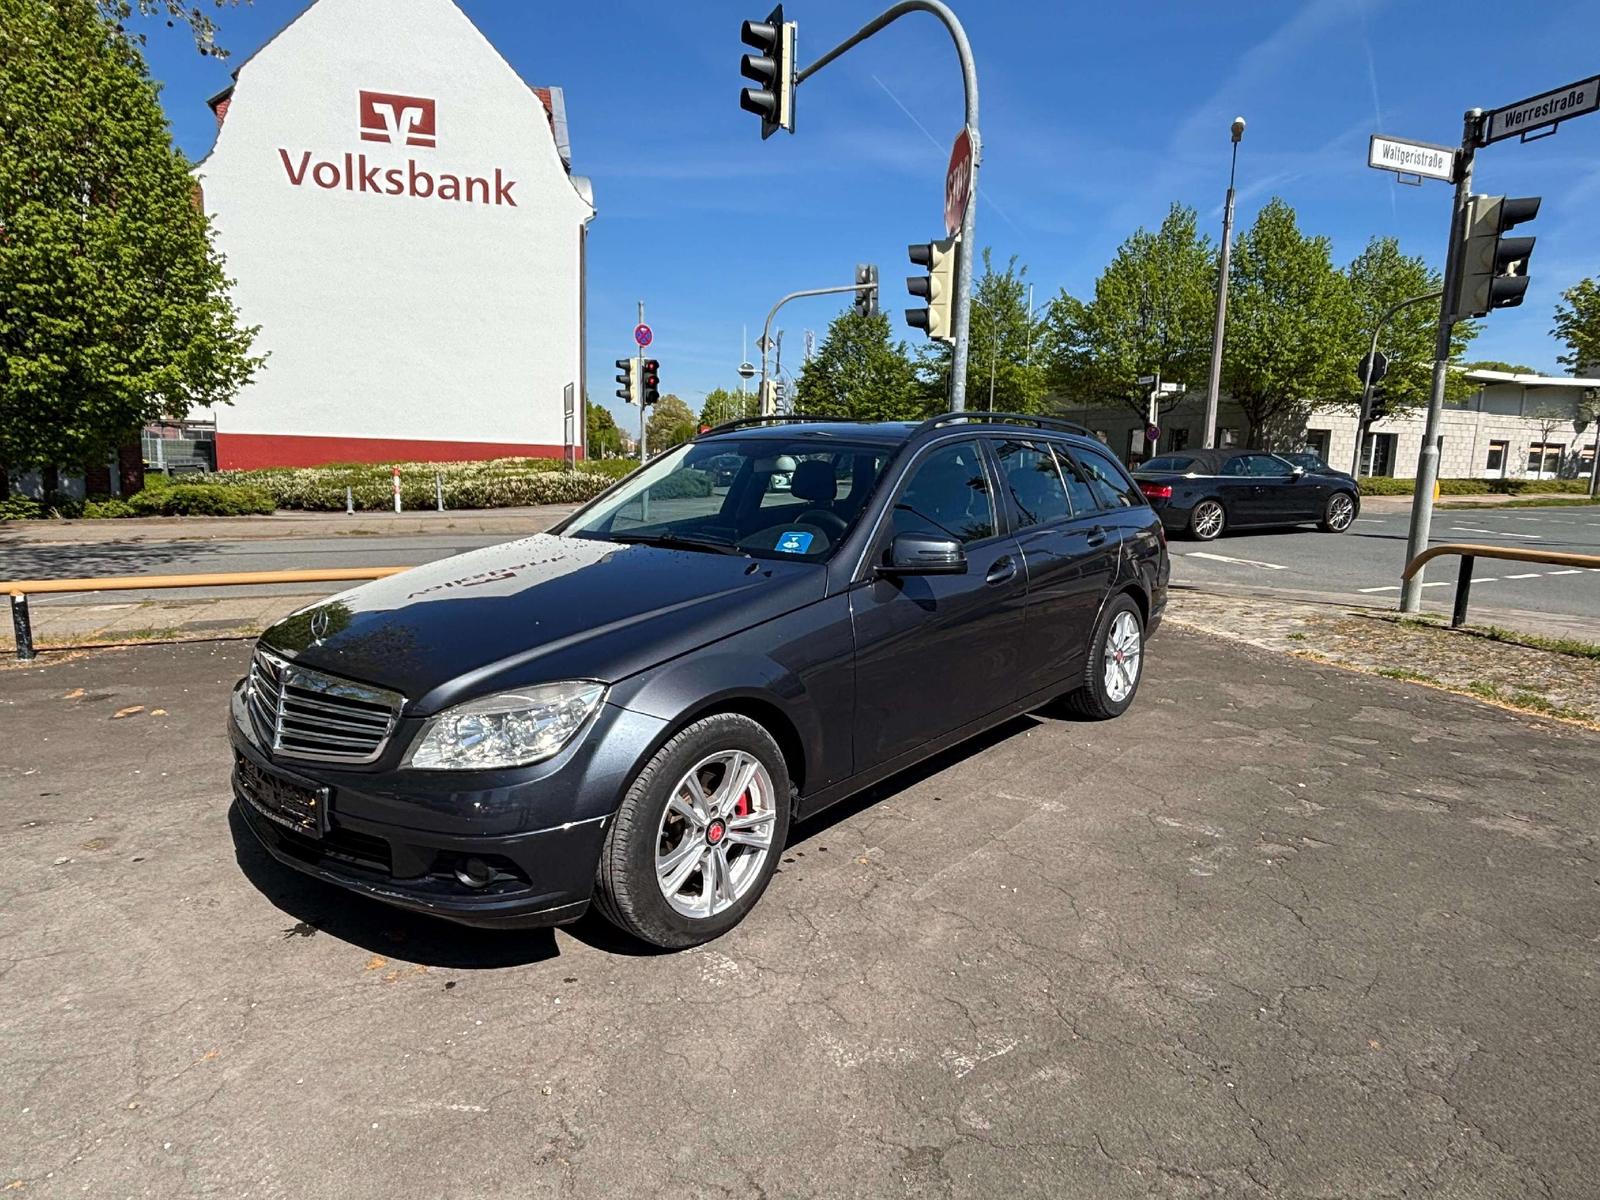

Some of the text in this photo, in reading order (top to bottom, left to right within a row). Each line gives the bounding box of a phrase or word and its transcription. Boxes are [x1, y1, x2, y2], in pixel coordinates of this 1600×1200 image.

[1505, 90, 1584, 128] Werrestraße
[278, 148, 518, 207] Volksbank
[1382, 143, 1443, 169] Waltgeristraße
[947, 154, 970, 212] STOP
